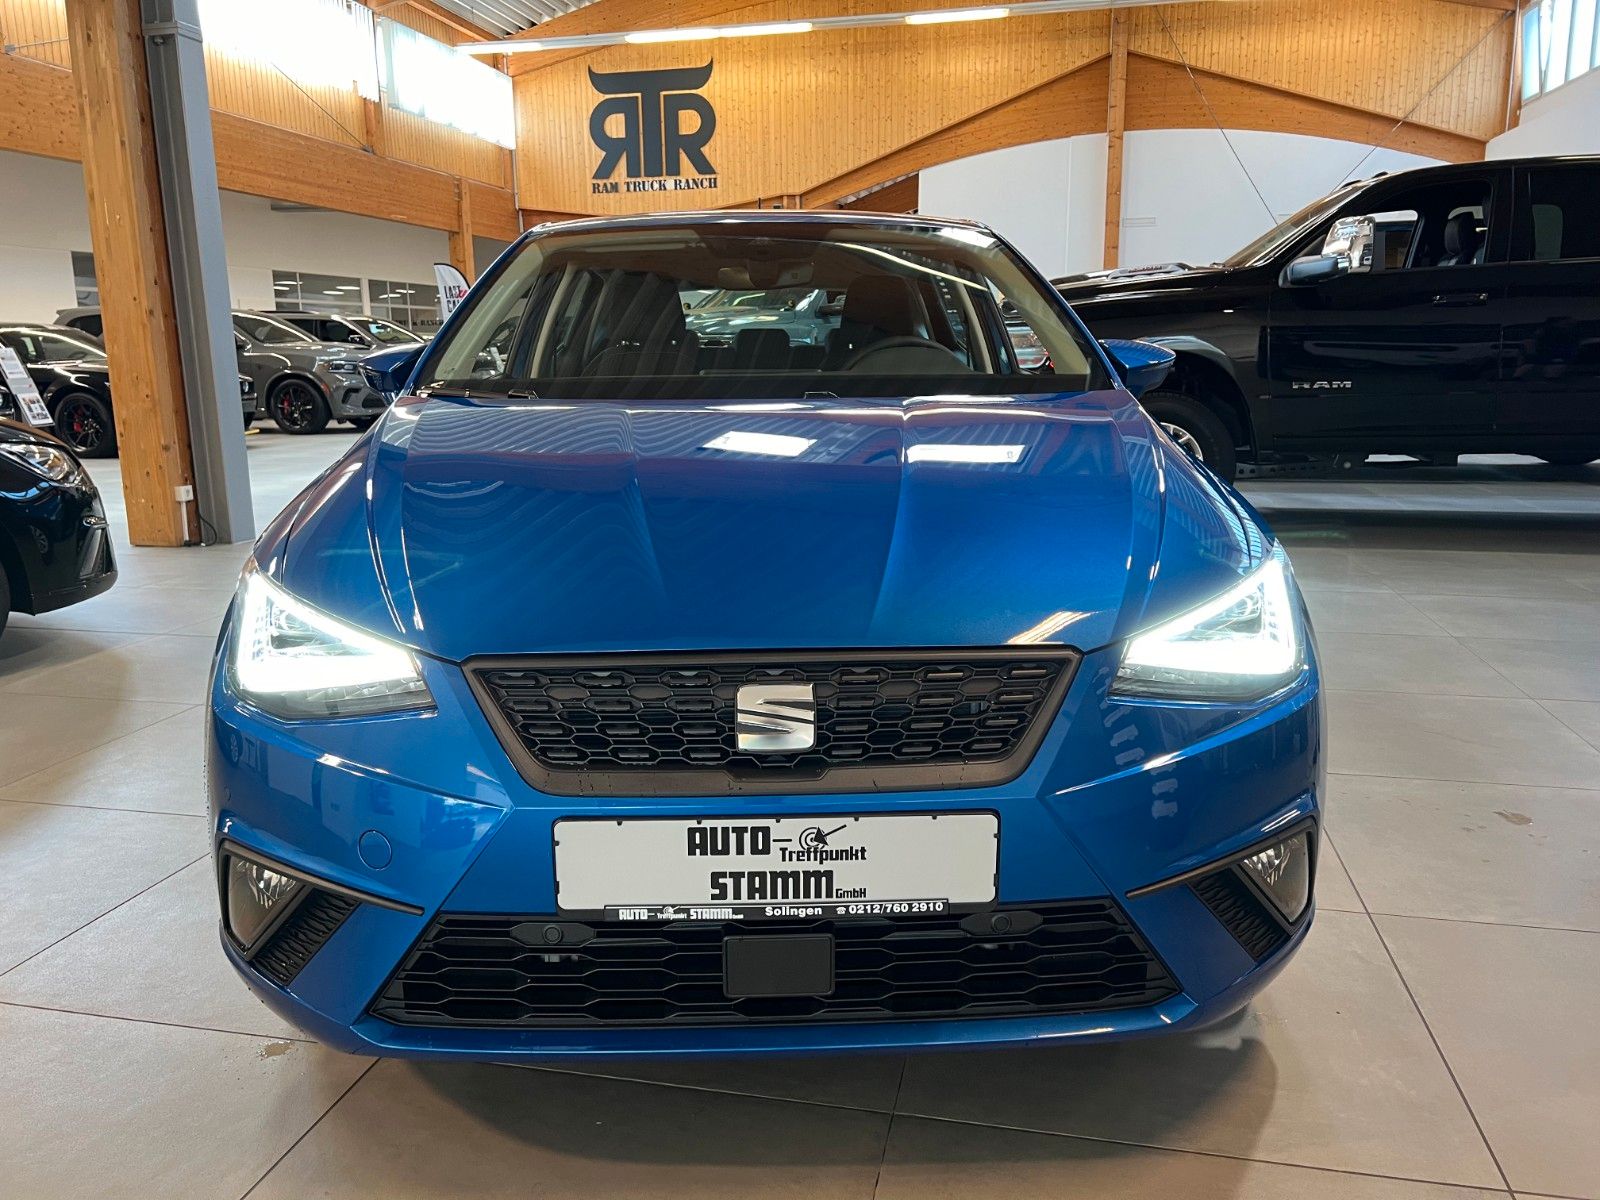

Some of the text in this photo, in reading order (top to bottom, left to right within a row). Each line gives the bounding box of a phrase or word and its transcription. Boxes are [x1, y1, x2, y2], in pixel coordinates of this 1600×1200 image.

[592, 177, 718, 194] RAM TRUCK RANCH
[1292, 381, 1352, 389] RAM
[779, 846, 867, 865] Treffpunkt
[710, 870, 867, 901] STAMM GmbH
[690, 908, 733, 920] STAMM
[765, 902, 944, 917] Solingen 0212/760 2910
